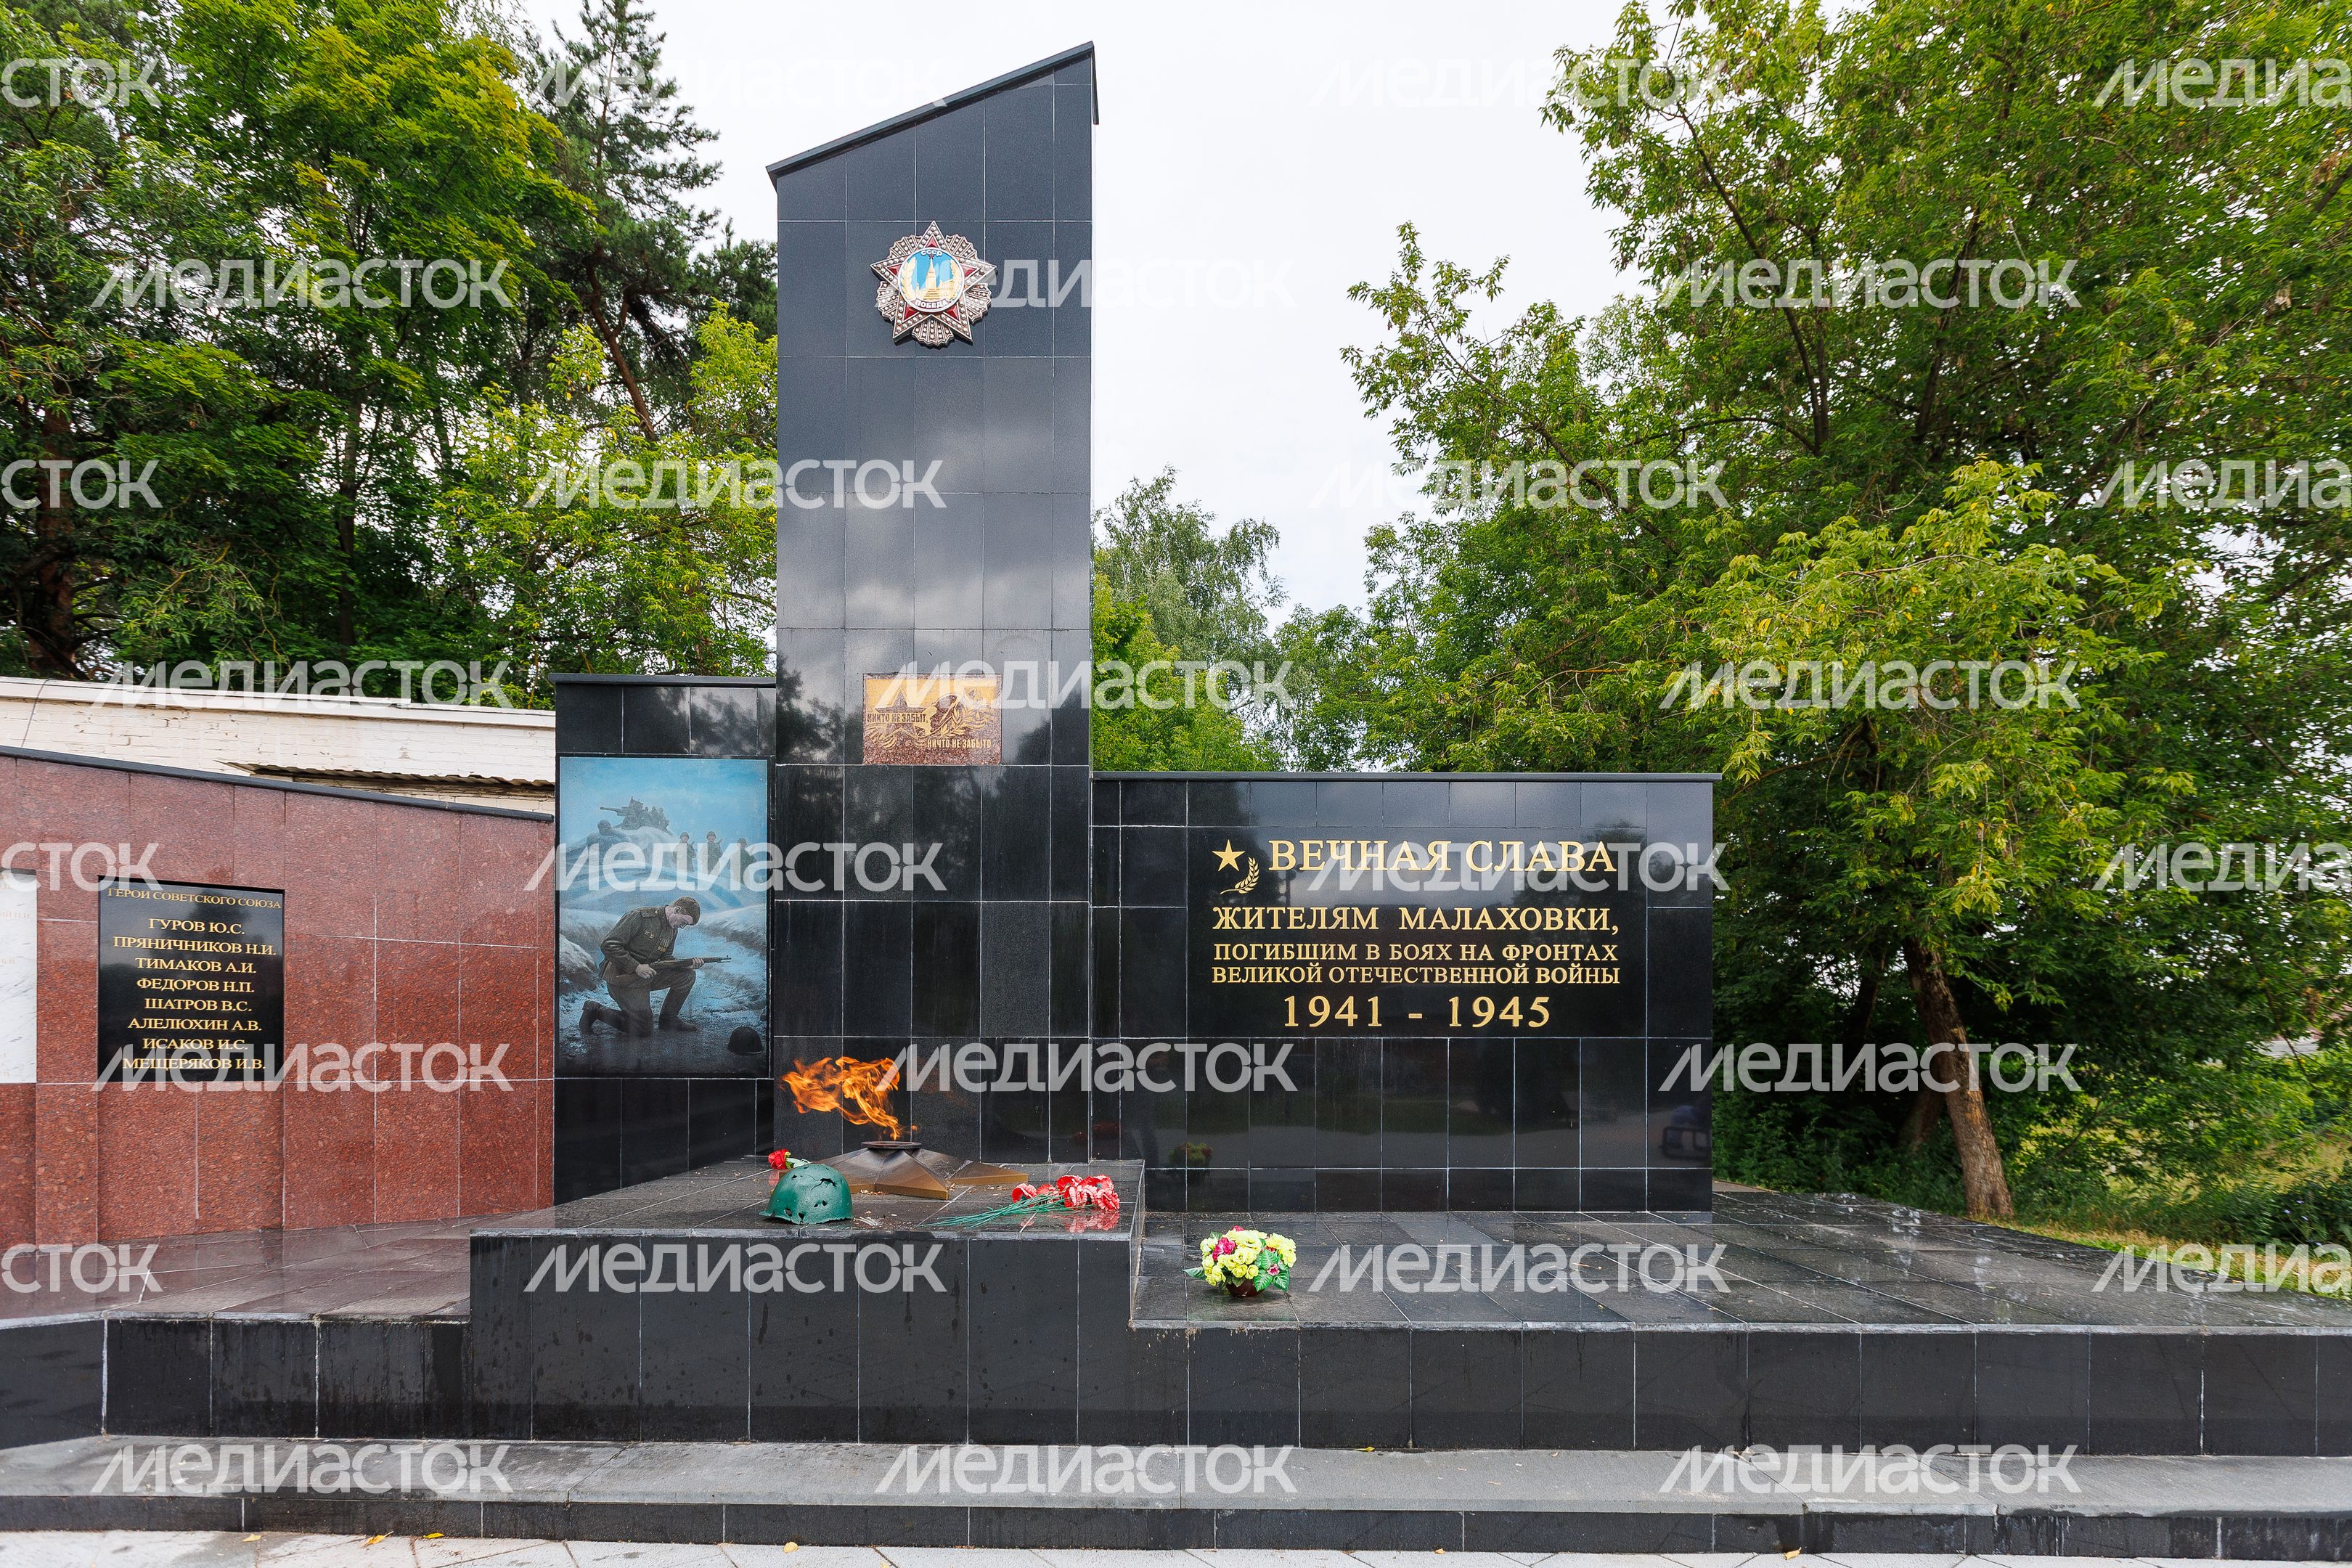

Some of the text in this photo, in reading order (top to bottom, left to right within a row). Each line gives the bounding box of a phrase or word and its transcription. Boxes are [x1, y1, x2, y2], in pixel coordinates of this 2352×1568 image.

[915, 298, 948, 309] ПОБЕДА
[892, 714, 901, 723] НЕ
[927, 739, 992, 748] НИЧТО НЕ ЗАБЫТО
[1268, 839, 1617, 873] ВЕЧНАЯ СЛАВА
[107, 888, 281, 909] ГЕРОИ СОВЕТСКОГО СОЮЗА
[148, 918, 245, 934] ГУРОВ Ю.С.
[1212, 907, 1620, 935] ЖИТЕЛЯМ МАЛАХОВКИ,
[113, 936, 277, 955] ПРЯНИЧНИКОВ Н.И.
[1213, 944, 1619, 962] ПОГИБШИМ В БОЯХ НА ФРОНТАХ
[135, 957, 256, 973] ТИМАКОВ А.И.
[1212, 962, 1620, 984] ВЕЛИКОЙ ОТЕЧЕСТВЕННОЙ ВОЙНЫ
[136, 979, 255, 992] ФЕДОРОВ Н.П.
[144, 998, 252, 1011] ШАТРОВ В.С.
[1283, 995, 1383, 1027] 1941
[1448, 996, 1551, 1027] 1945
[127, 1018, 262, 1031] АЛЕЛЮХИН А.В.
[142, 1038, 248, 1050] ИСАКОВ И.С.
[235, 1059, 266, 1069] И.В.
